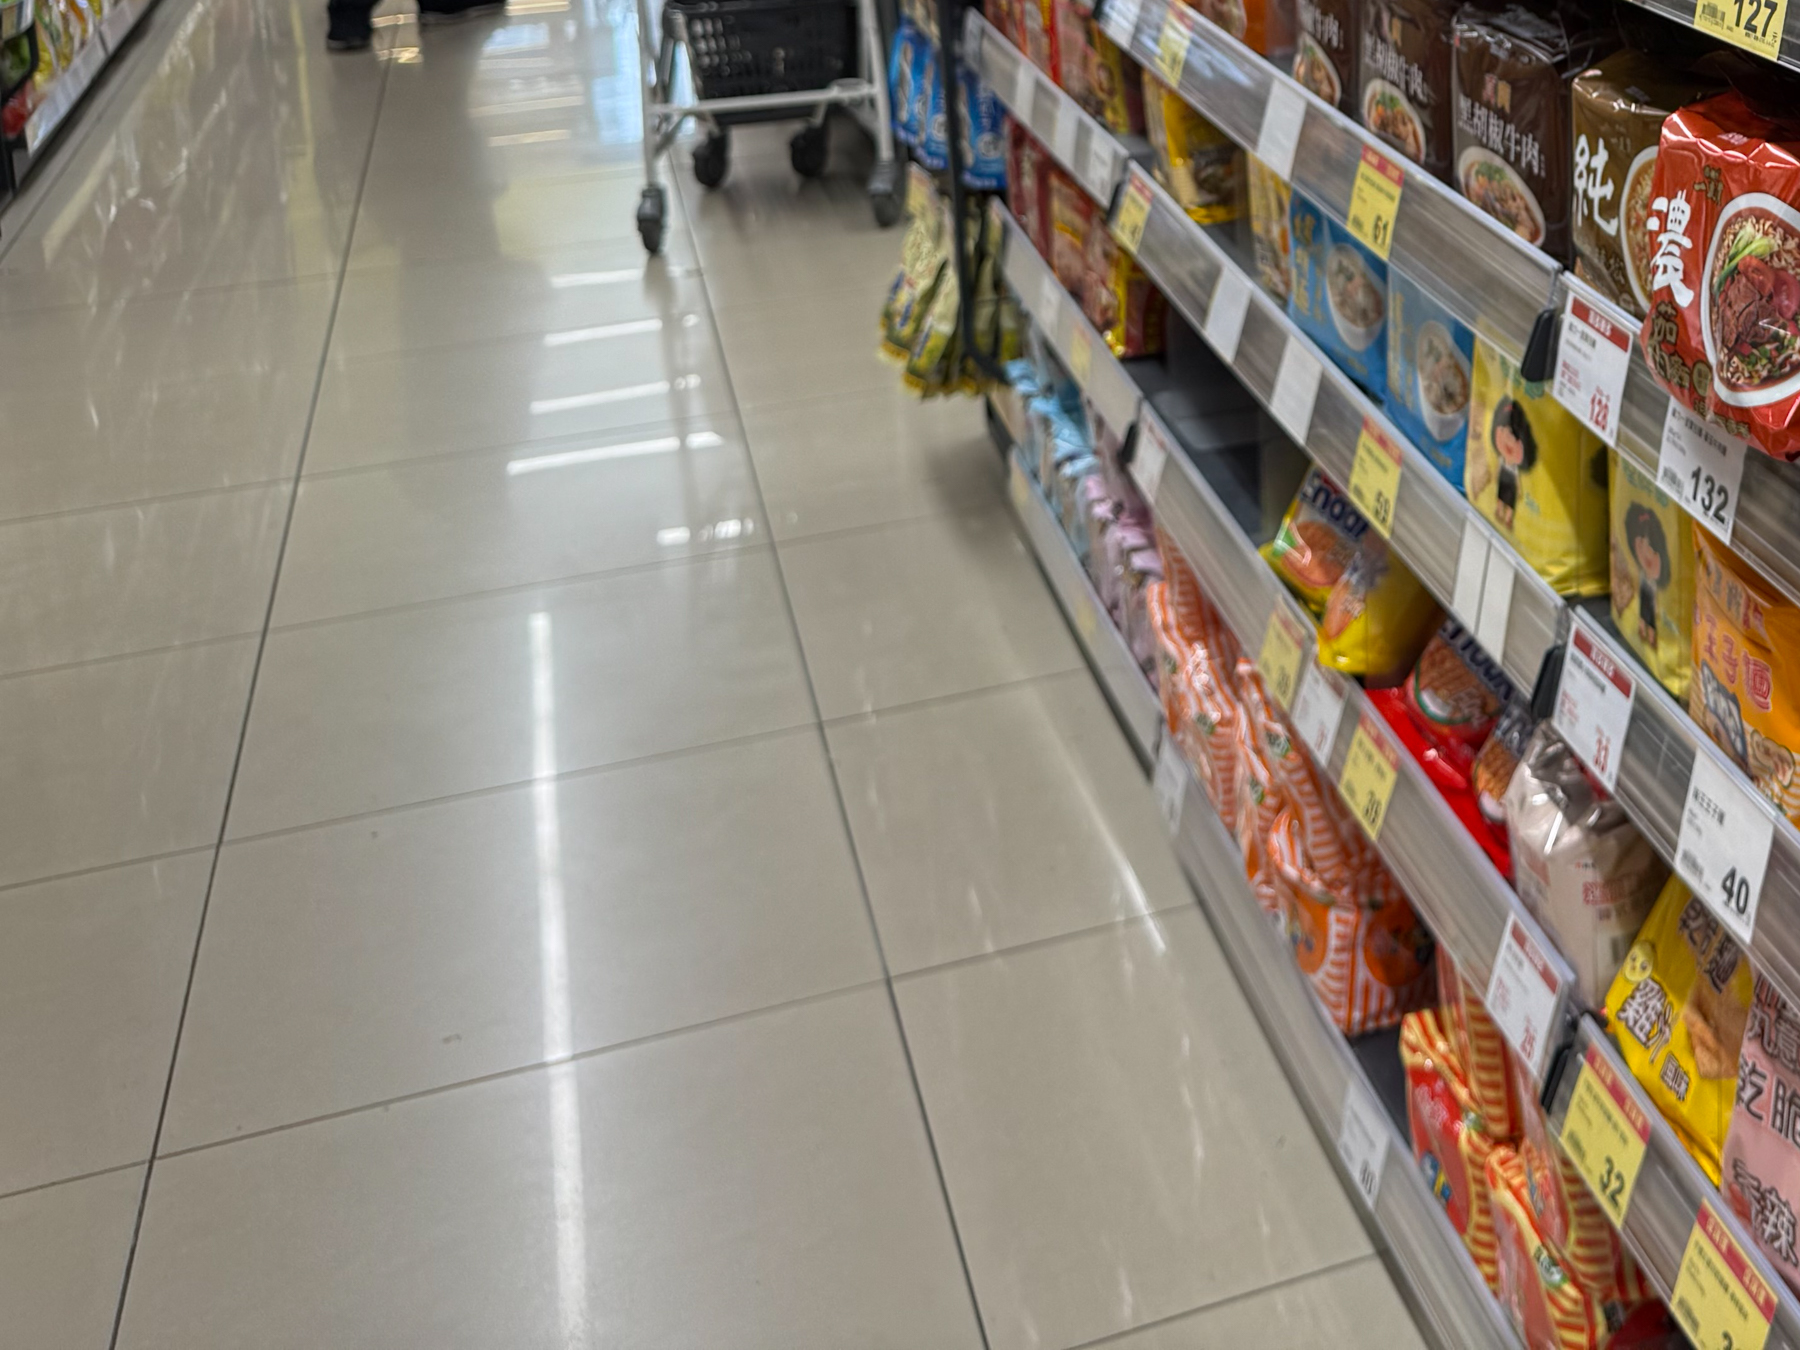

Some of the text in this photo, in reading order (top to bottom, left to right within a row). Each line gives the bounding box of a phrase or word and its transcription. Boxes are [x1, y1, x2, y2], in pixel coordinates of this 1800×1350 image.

[1572, 133, 1619, 237] 純
[1645, 189, 1694, 308] 濃
[1690, 466, 1730, 525] 132
[1720, 866, 1750, 916] 40
[1600, 1155, 1625, 1208] 32
